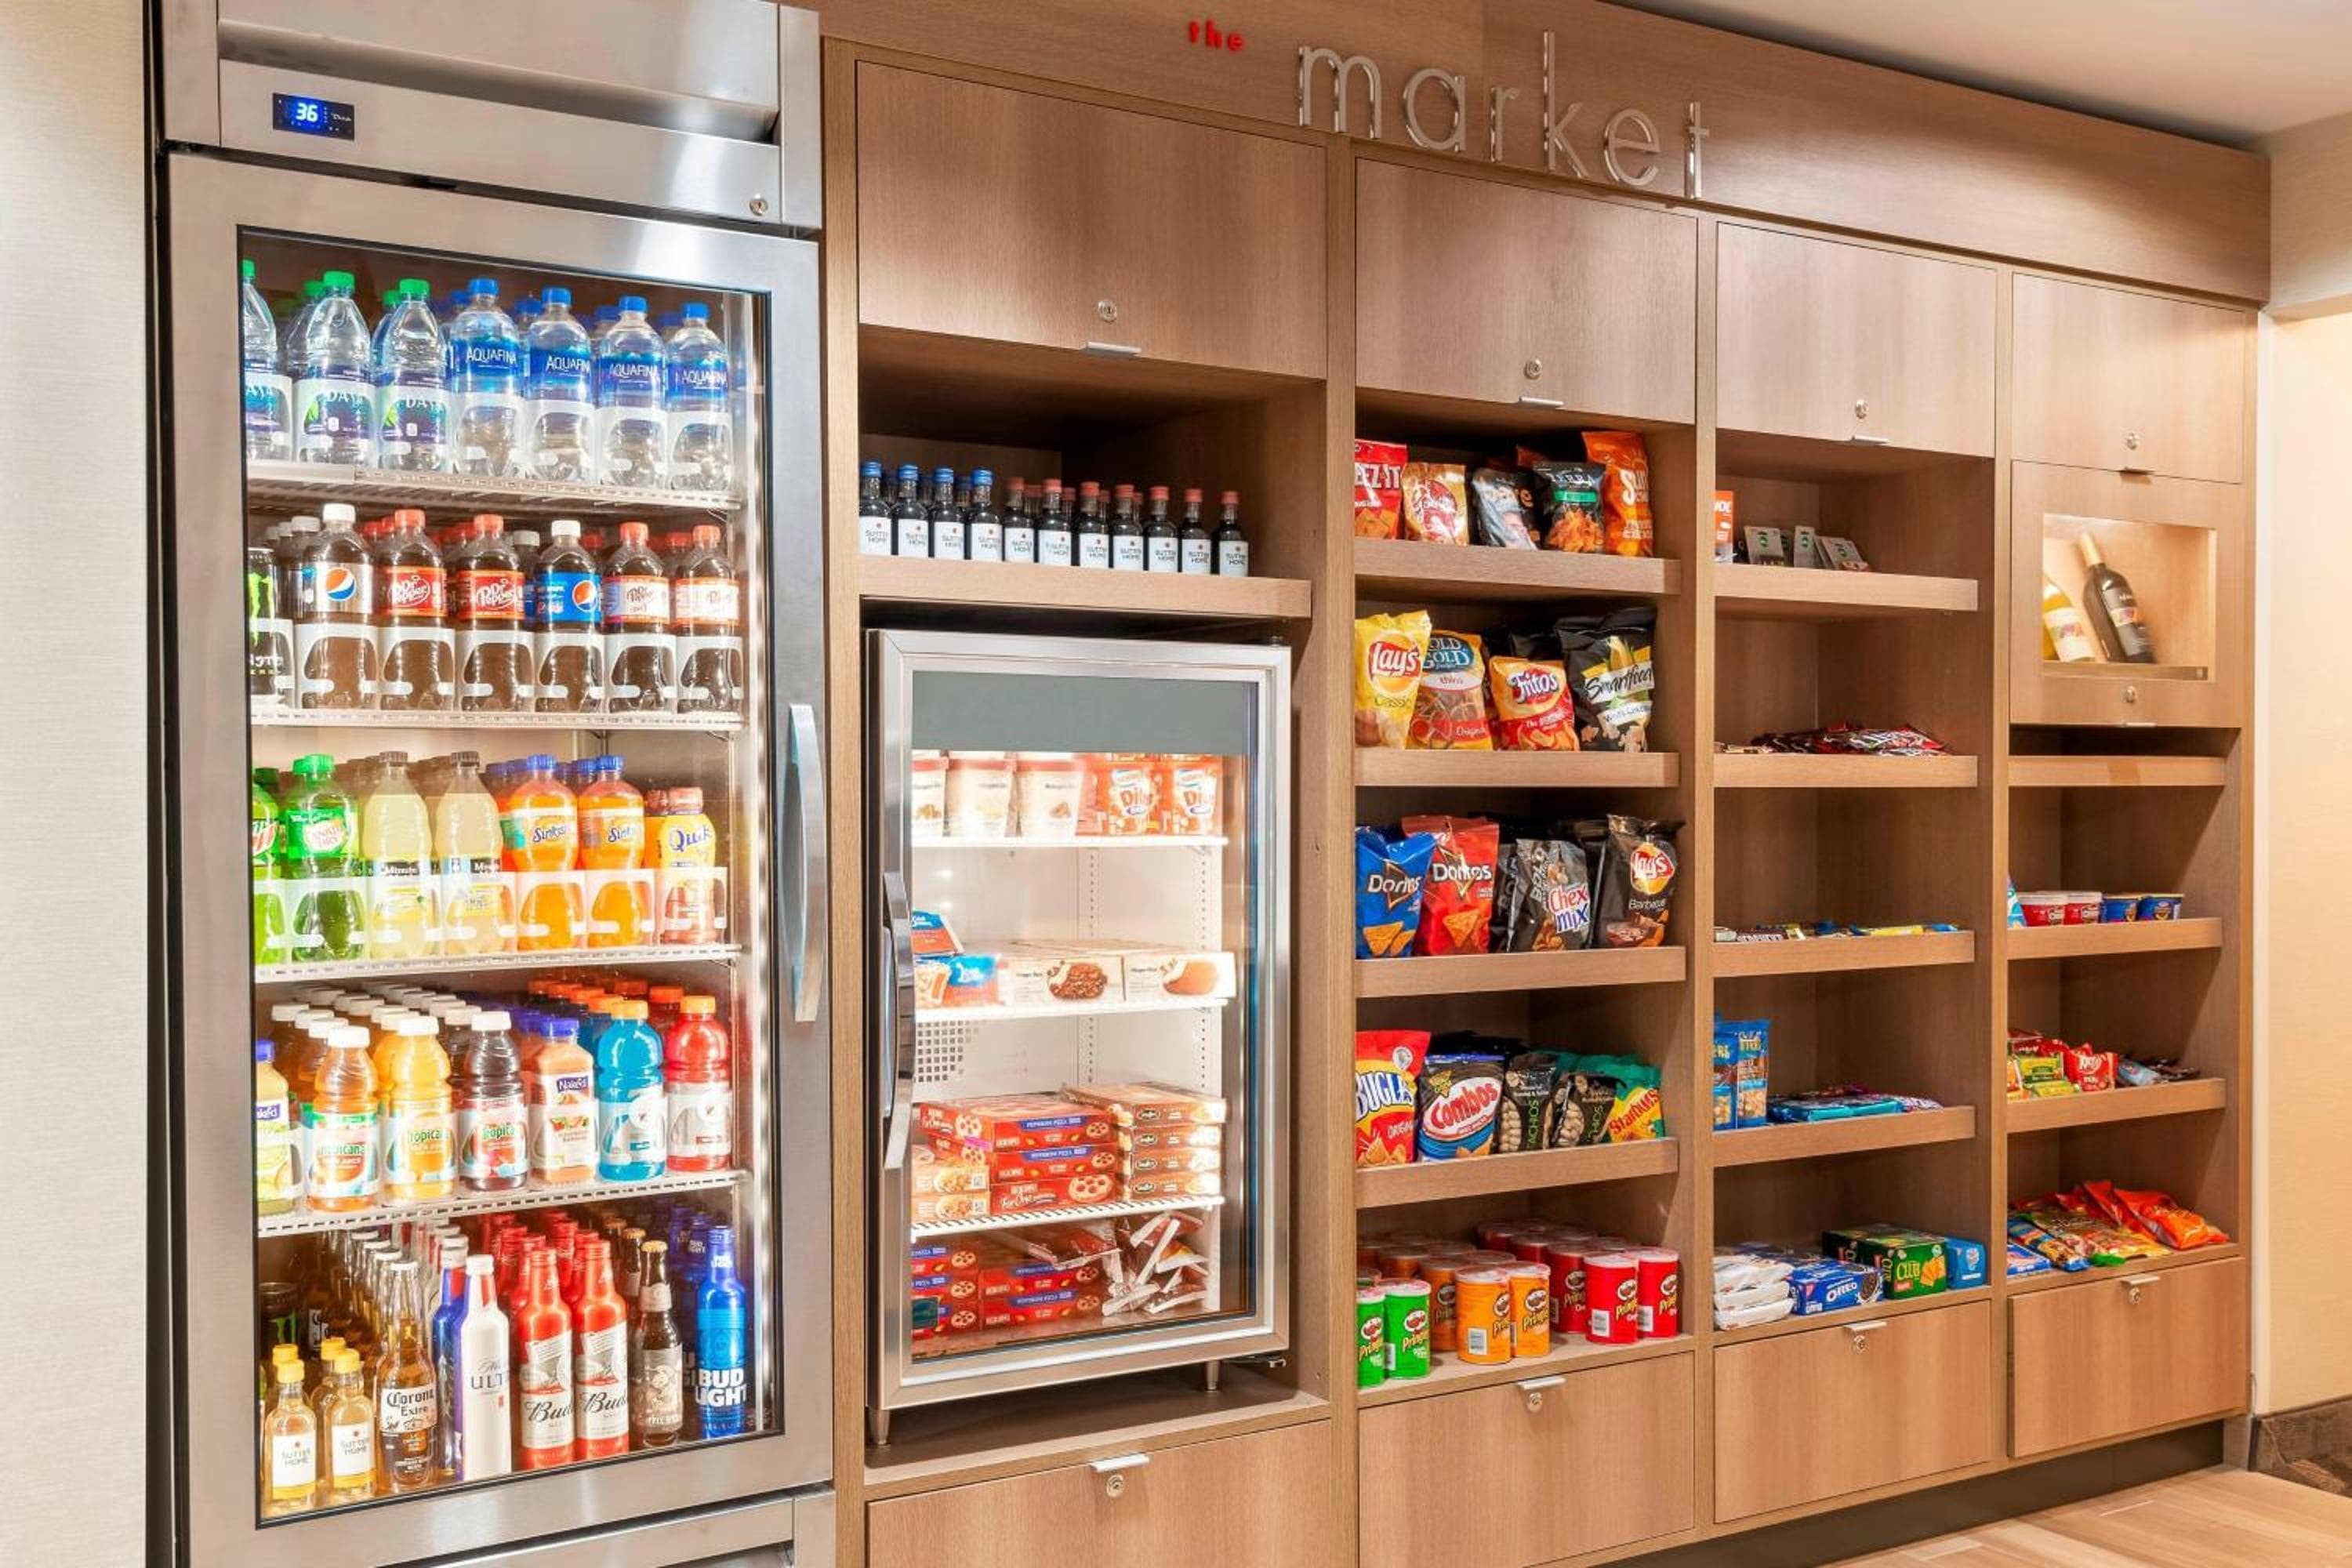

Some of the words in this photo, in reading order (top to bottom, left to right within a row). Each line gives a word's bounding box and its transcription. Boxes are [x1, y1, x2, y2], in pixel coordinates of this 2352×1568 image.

[296, 102, 318, 123] 36
[1188, 20, 1244, 53] the
[1298, 29, 1710, 200] market
[466, 347, 517, 365] AQUAFINA
[546, 355, 591, 374] AQUAFIN
[1507, 671, 1559, 703] Fritos
[1432, 862, 1493, 882] Doritos
[1548, 884, 1588, 915] Chex
[1431, 1082, 1499, 1130] Combos
[1826, 1282, 1857, 1302] OREO
[698, 1368, 744, 1388] BUD
[387, 1388, 434, 1408] Corona
[695, 1385, 747, 1407] LIGHT
